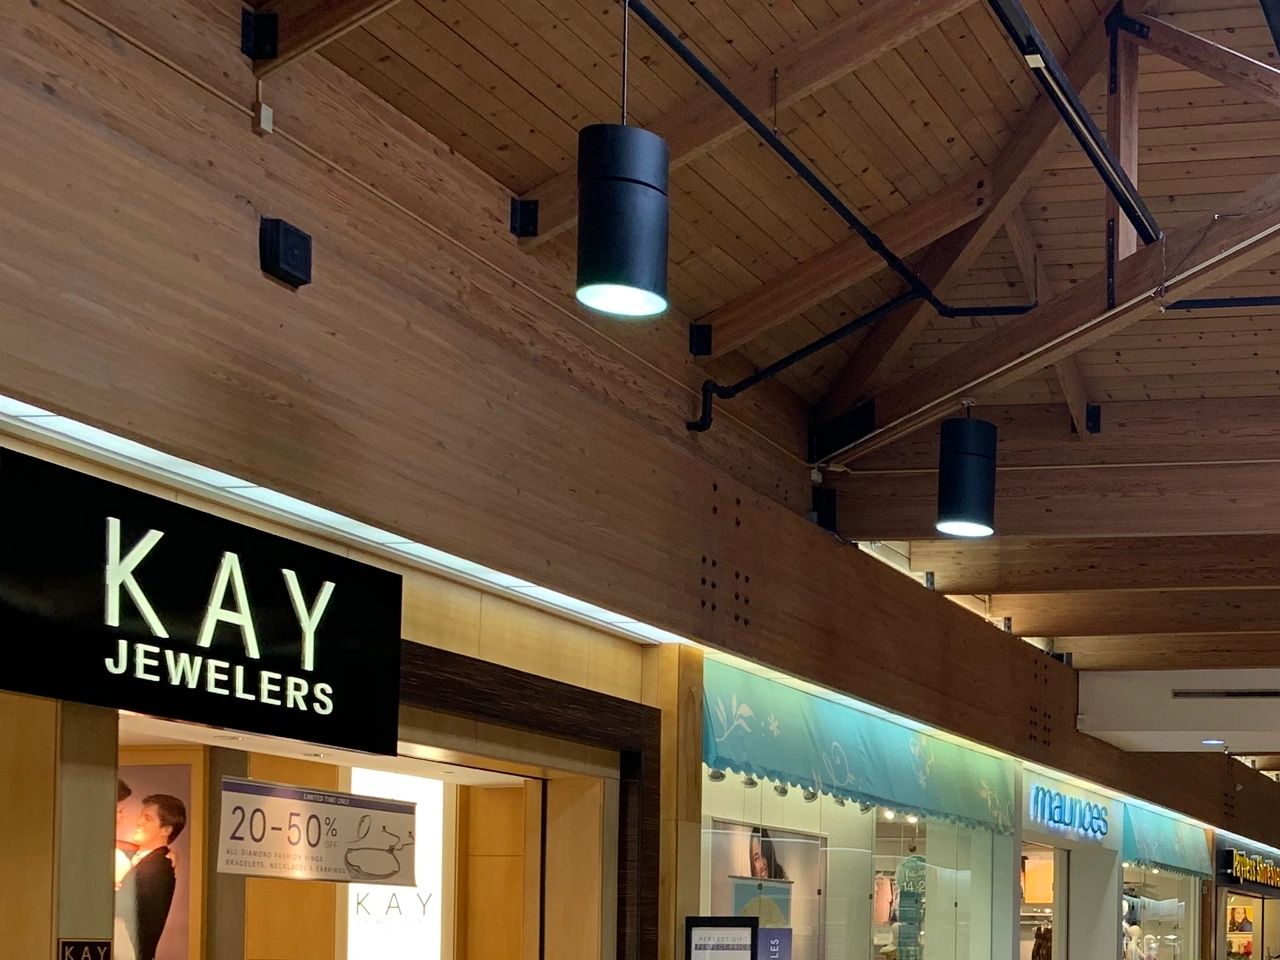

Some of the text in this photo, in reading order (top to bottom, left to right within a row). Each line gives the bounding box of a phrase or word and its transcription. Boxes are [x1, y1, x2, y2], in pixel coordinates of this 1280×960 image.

[104, 516, 337, 672] KAY
[104, 639, 334, 716] JEWELERS
[303, 793, 324, 802] LIMITED
[324, 841, 337, 849] OFF
[225, 849, 323, 862] ALL DIAMOND FASHION RINGS
[269, 860, 309, 872] NECKLACES
[315, 865, 346, 875] EARRINGS
[356, 892, 432, 916] KAY
[65, 946, 107, 960] KAY
